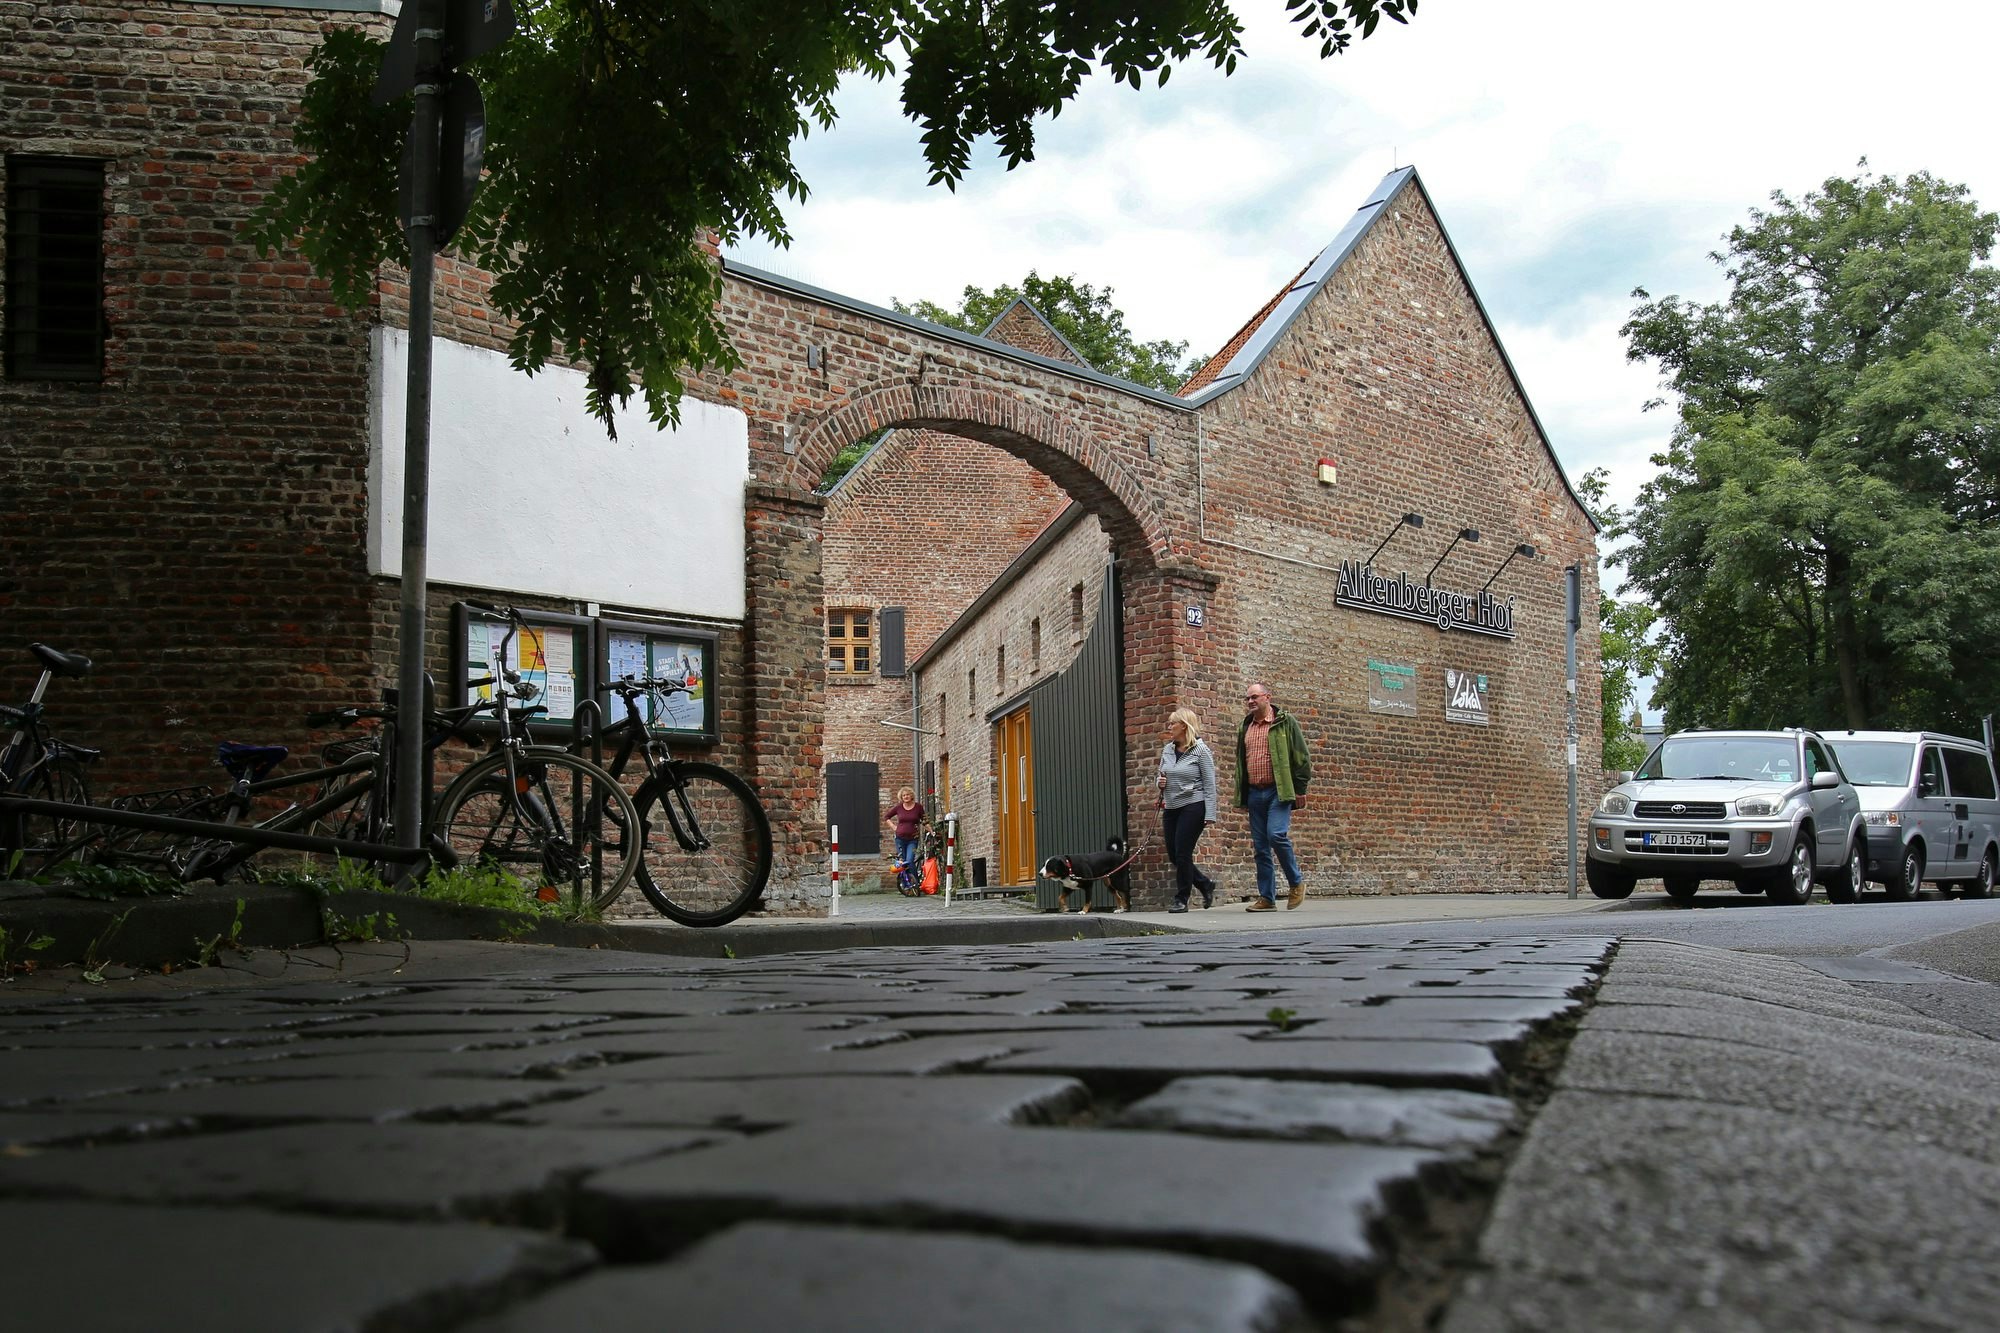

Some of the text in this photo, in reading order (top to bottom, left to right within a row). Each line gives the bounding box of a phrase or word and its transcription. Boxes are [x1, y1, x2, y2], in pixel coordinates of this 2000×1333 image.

[1336, 559, 1515, 631] Altenberger Hof
[1188, 609, 1202, 624] 92
[658, 656, 675, 665] STADT
[655, 664, 670, 672] LAND
[1451, 672, 1482, 711] Lokal
[1651, 835, 1705, 846] K ID 1571
